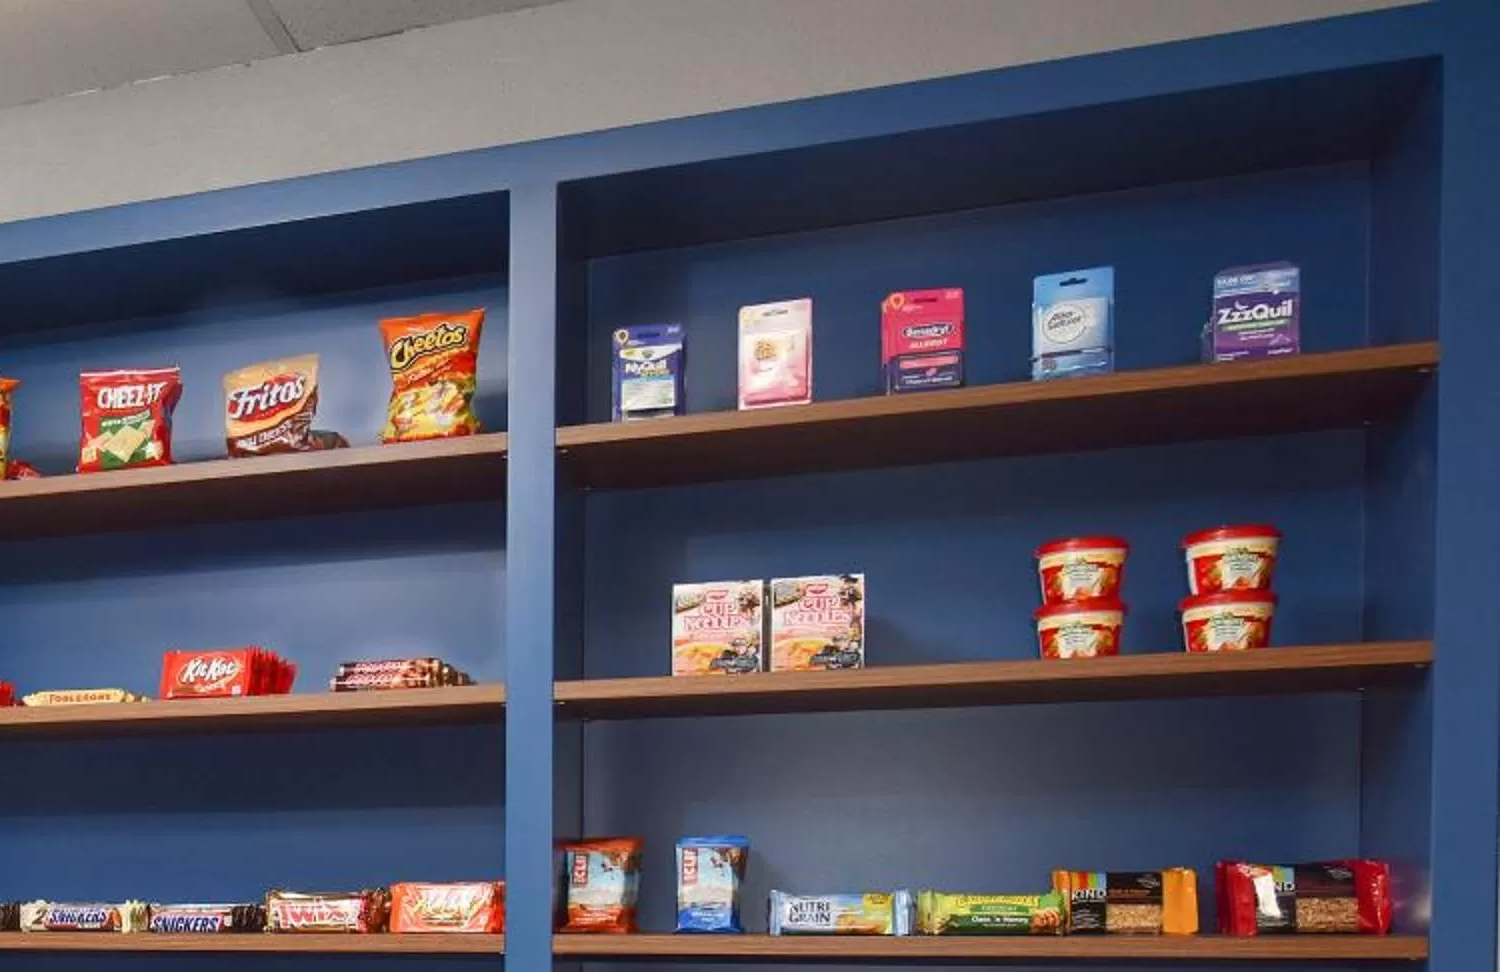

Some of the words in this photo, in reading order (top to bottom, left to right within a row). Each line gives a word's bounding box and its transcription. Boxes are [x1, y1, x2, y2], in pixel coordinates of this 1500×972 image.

[1217, 299, 1293, 325] ZzzQuil
[391, 323, 468, 369] Cheetos
[97, 381, 168, 409] CHEEZ-IT
[229, 375, 304, 419] Fritos
[701, 602, 737, 617] CUP
[800, 596, 841, 612] CUP
[684, 615, 752, 632] NOODLES
[784, 610, 851, 626] NOODLES
[1072, 889, 1107, 901] KIND
[788, 901, 831, 914] NUTRI
[48, 908, 108, 925] SNICKERS
[151, 914, 220, 933] SNICKERS
[787, 912, 832, 924] GRAIN
